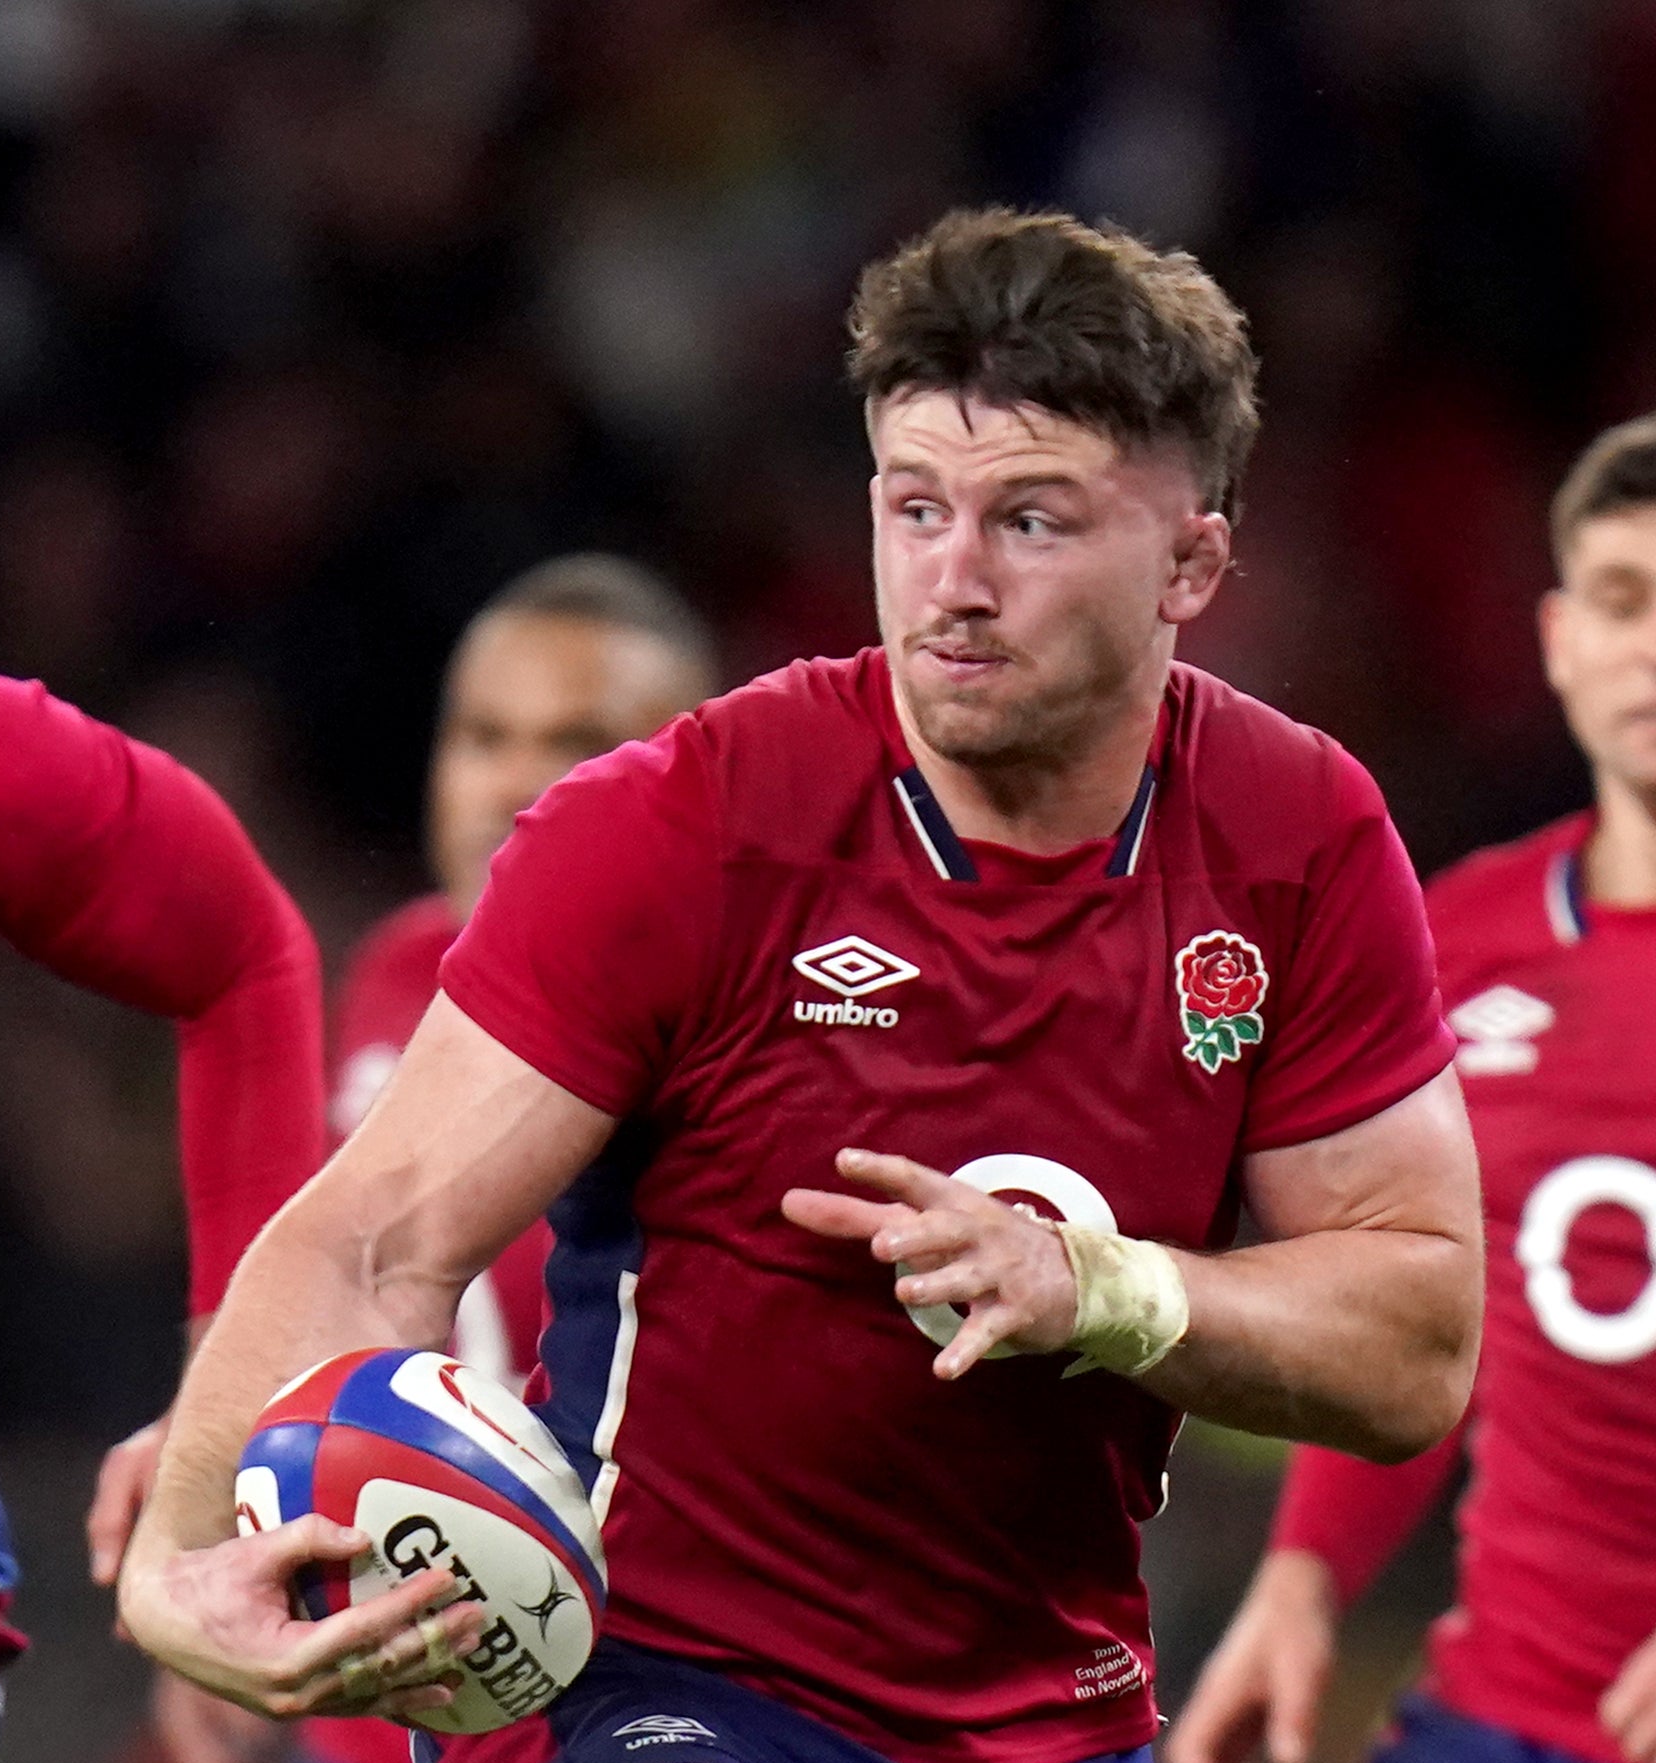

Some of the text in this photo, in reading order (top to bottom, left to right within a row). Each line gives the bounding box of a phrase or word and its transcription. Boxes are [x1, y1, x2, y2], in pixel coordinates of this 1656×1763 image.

[793, 997, 899, 1029] umbro
[384, 1514, 566, 1719] GLBER
[1075, 1652, 1130, 1681] England
[1092, 1643, 1121, 1661] Tom
